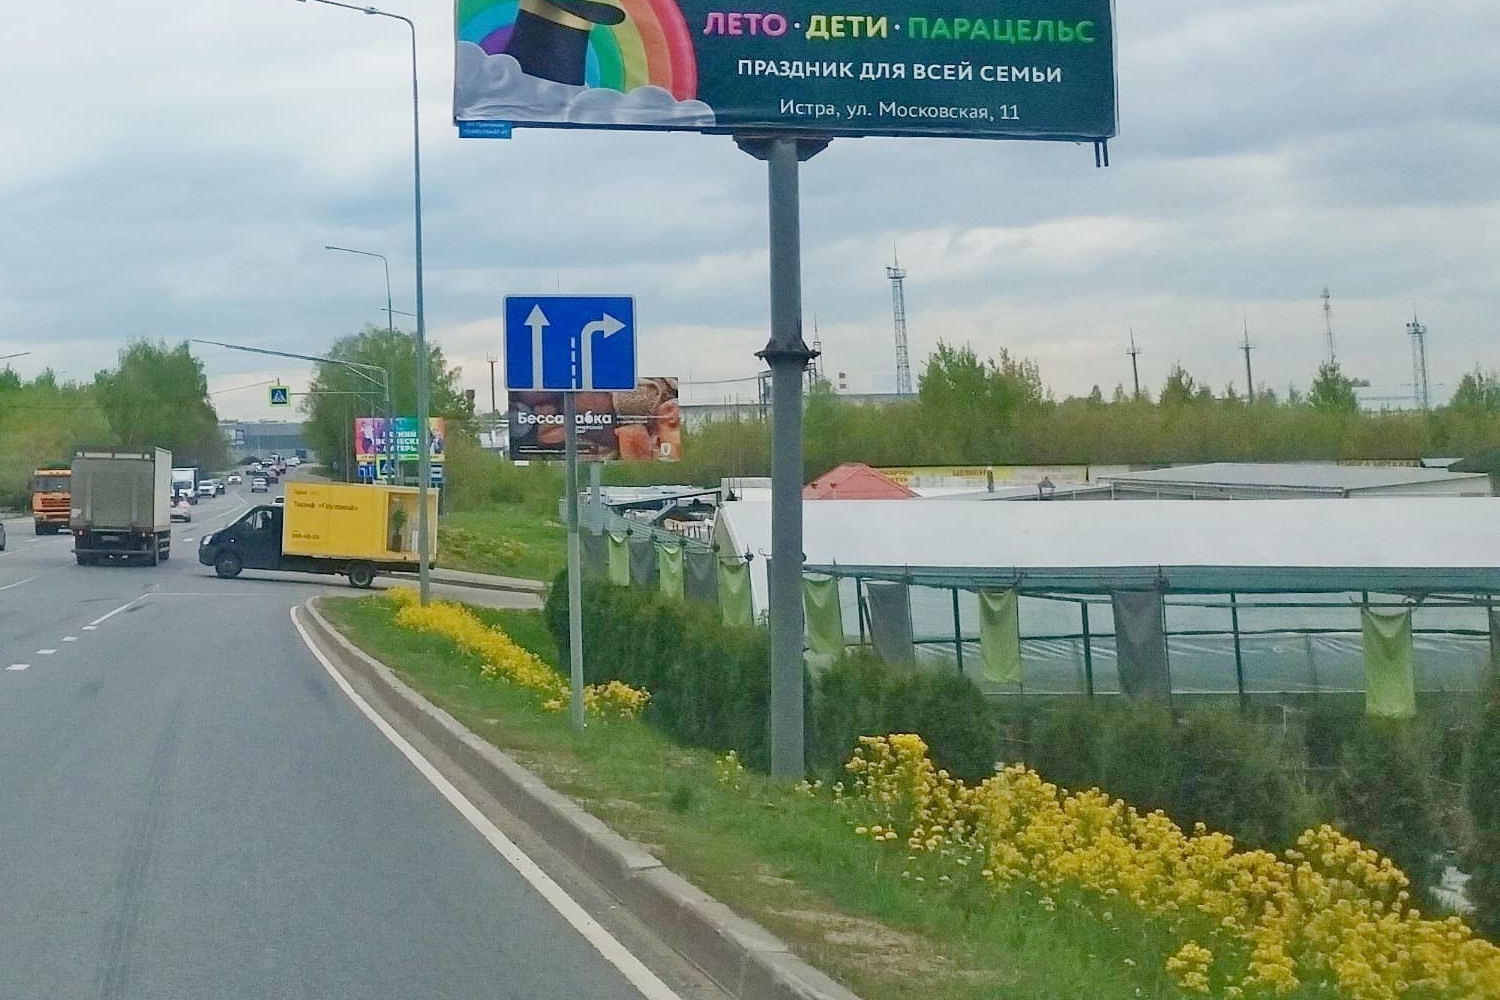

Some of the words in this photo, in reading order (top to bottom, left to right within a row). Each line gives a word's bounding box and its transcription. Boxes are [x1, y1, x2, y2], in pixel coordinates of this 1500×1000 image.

[703, 12, 787, 37] ЛЕТО
[805, 15, 888, 40] ДЕТИ
[908, 16, 1096, 45] ПАРАЦЕЛЬС
[737, 59, 854, 79] ПРАЗДНИК
[859, 62, 906, 80] ДЛЯ
[912, 60, 973, 81] ВСЕЙ
[979, 65, 1062, 83] СЕМЬИ
[779, 98, 841, 118] Истра,
[846, 102, 872, 119] ул.
[878, 101, 995, 122] Московская,
[999, 104, 1020, 120] 11
[517, 411, 612, 425] Бессаабка
